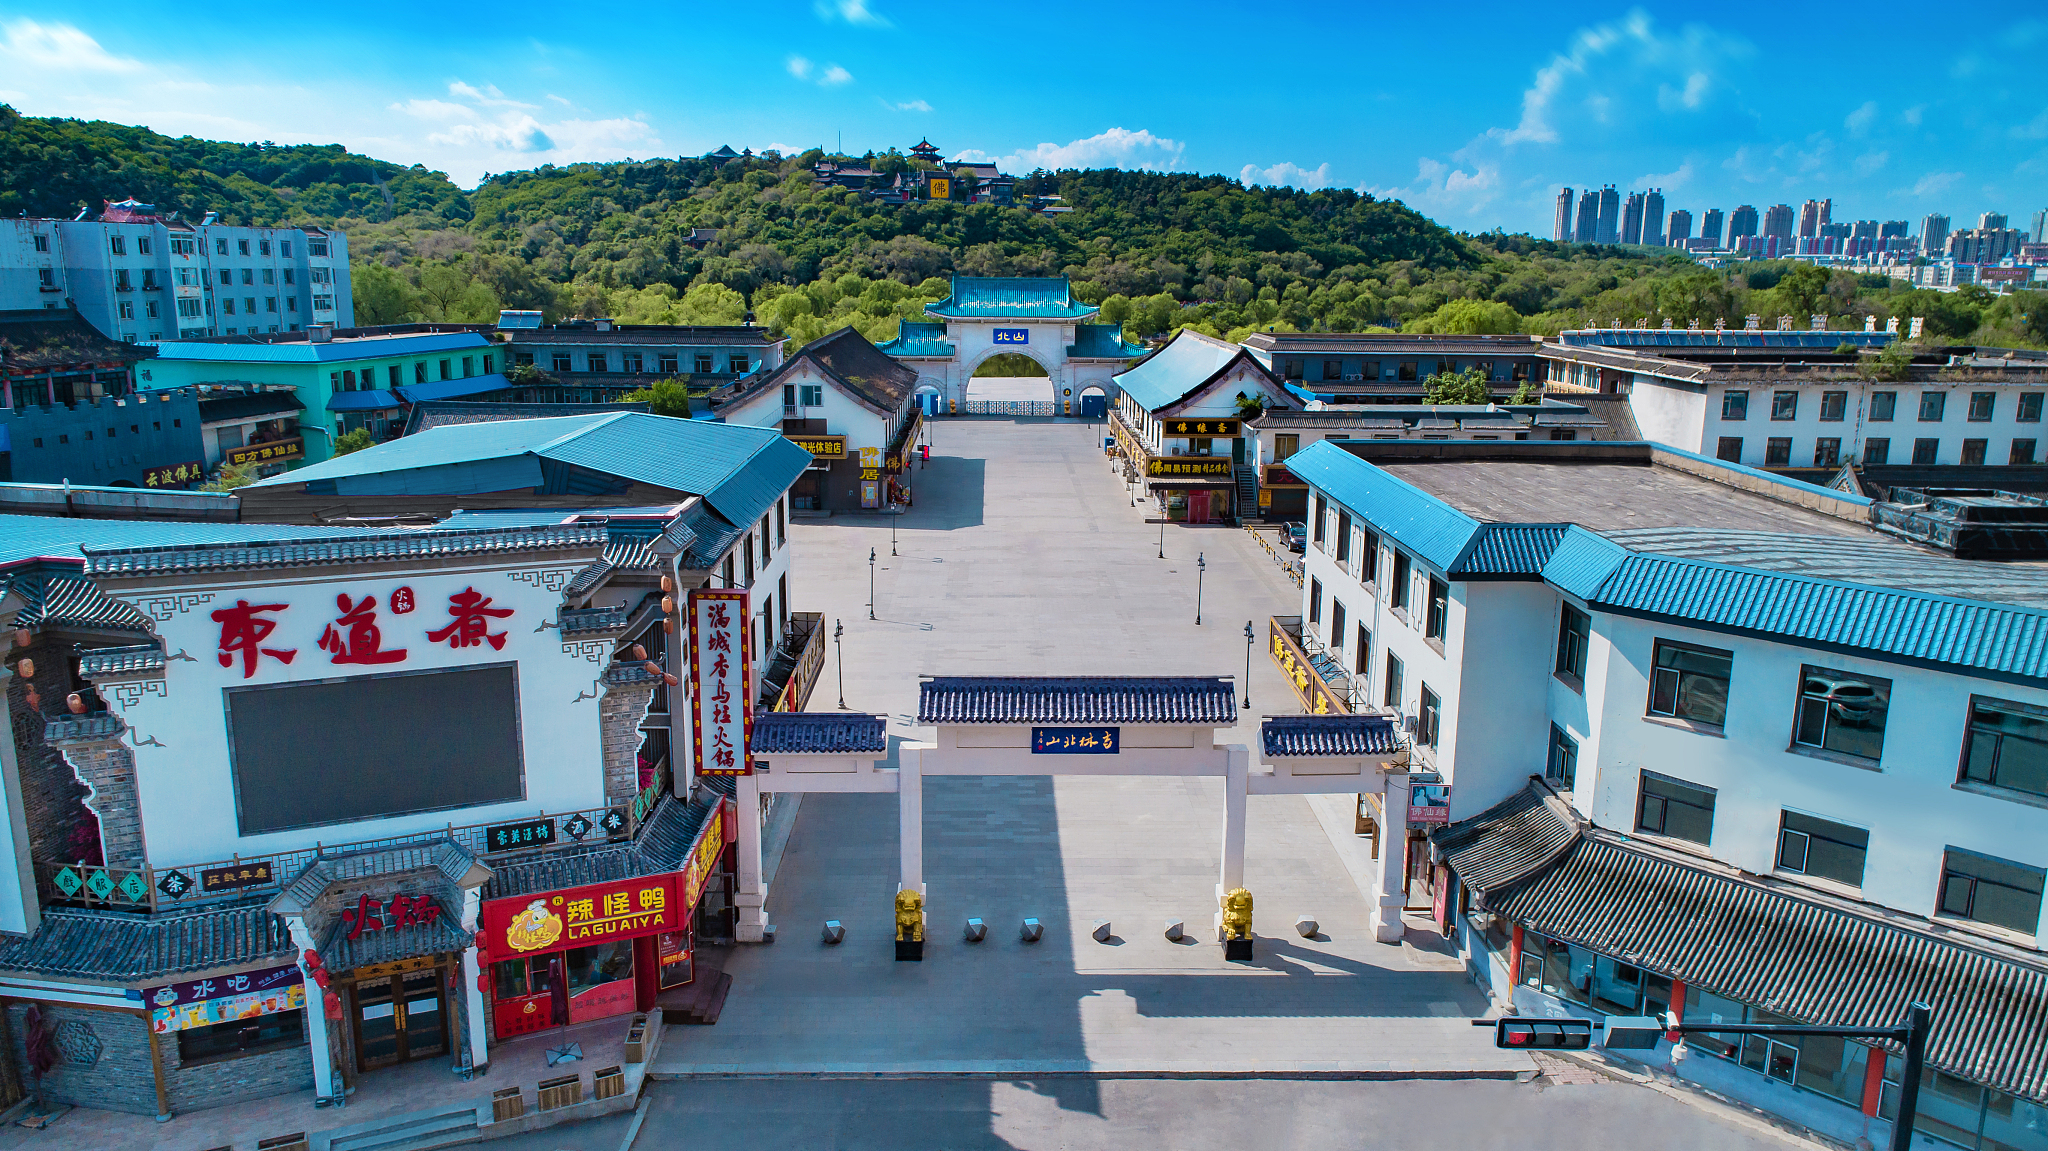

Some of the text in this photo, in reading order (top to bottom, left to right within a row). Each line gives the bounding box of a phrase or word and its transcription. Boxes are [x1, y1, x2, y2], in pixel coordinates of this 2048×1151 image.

[933, 181, 947, 196] 佛
[997, 331, 1025, 341] 北山
[168, 875, 185, 893] 茶
[567, 886, 666, 923] 辣怪鸭
[568, 914, 665, 940] LAGUAIYA
[192, 975, 250, 999] 水吧
